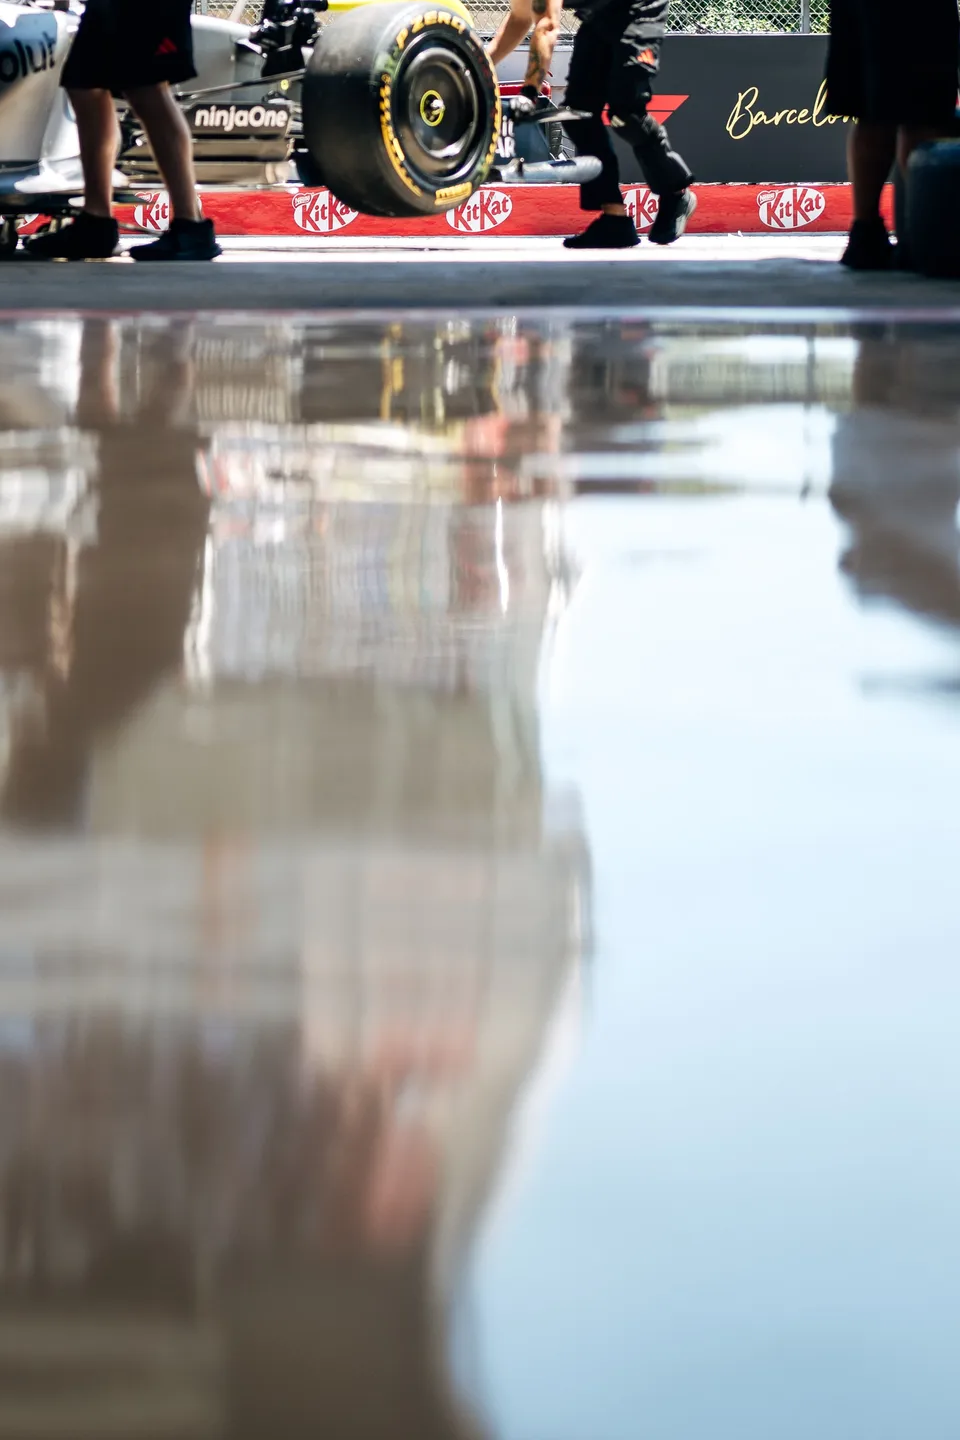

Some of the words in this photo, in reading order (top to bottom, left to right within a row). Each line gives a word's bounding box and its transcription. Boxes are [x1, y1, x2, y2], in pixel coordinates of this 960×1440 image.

[194, 104, 289, 132] ninjaOne
[725, 78, 859, 140] Barcelo
[142, 192, 169, 230] Kit
[301, 190, 357, 232] KitKa
[453, 189, 511, 231] KitKat
[766, 188, 822, 228] KitKat
